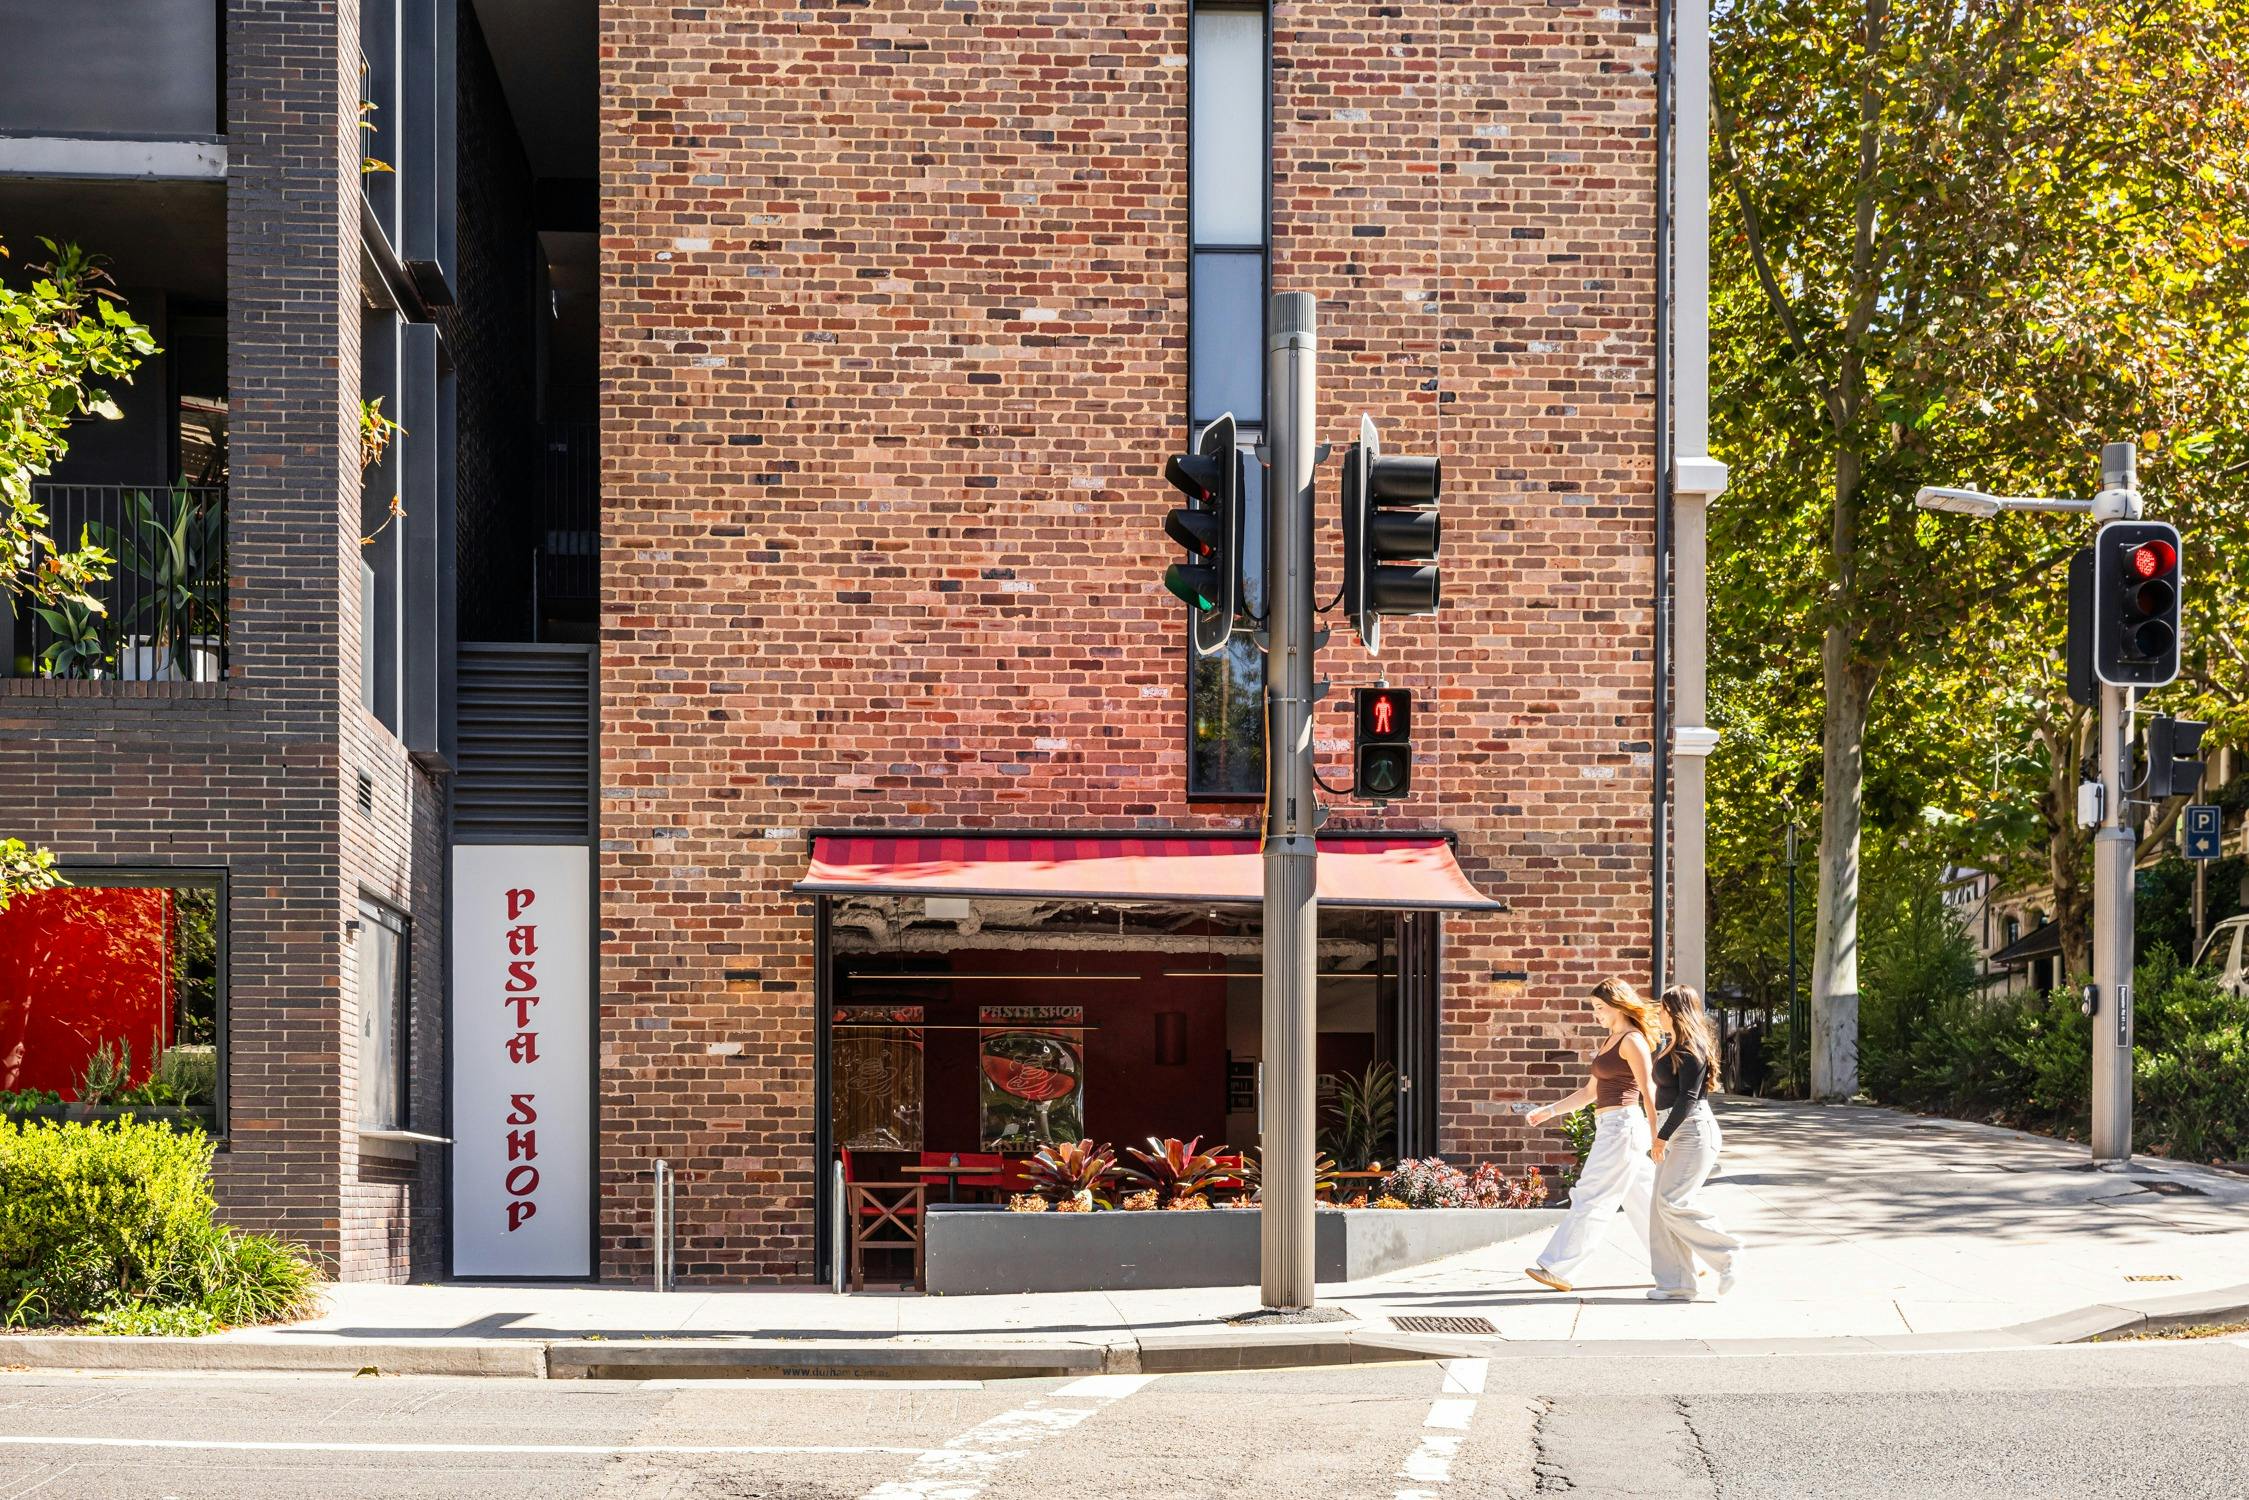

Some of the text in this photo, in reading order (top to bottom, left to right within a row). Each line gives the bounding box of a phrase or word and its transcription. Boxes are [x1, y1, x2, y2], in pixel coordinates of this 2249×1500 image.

[2198, 814, 2210, 829] P
[981, 1006, 1082, 1018] PASTA SHOP
[505, 889, 540, 1231] PASTA SHOP
